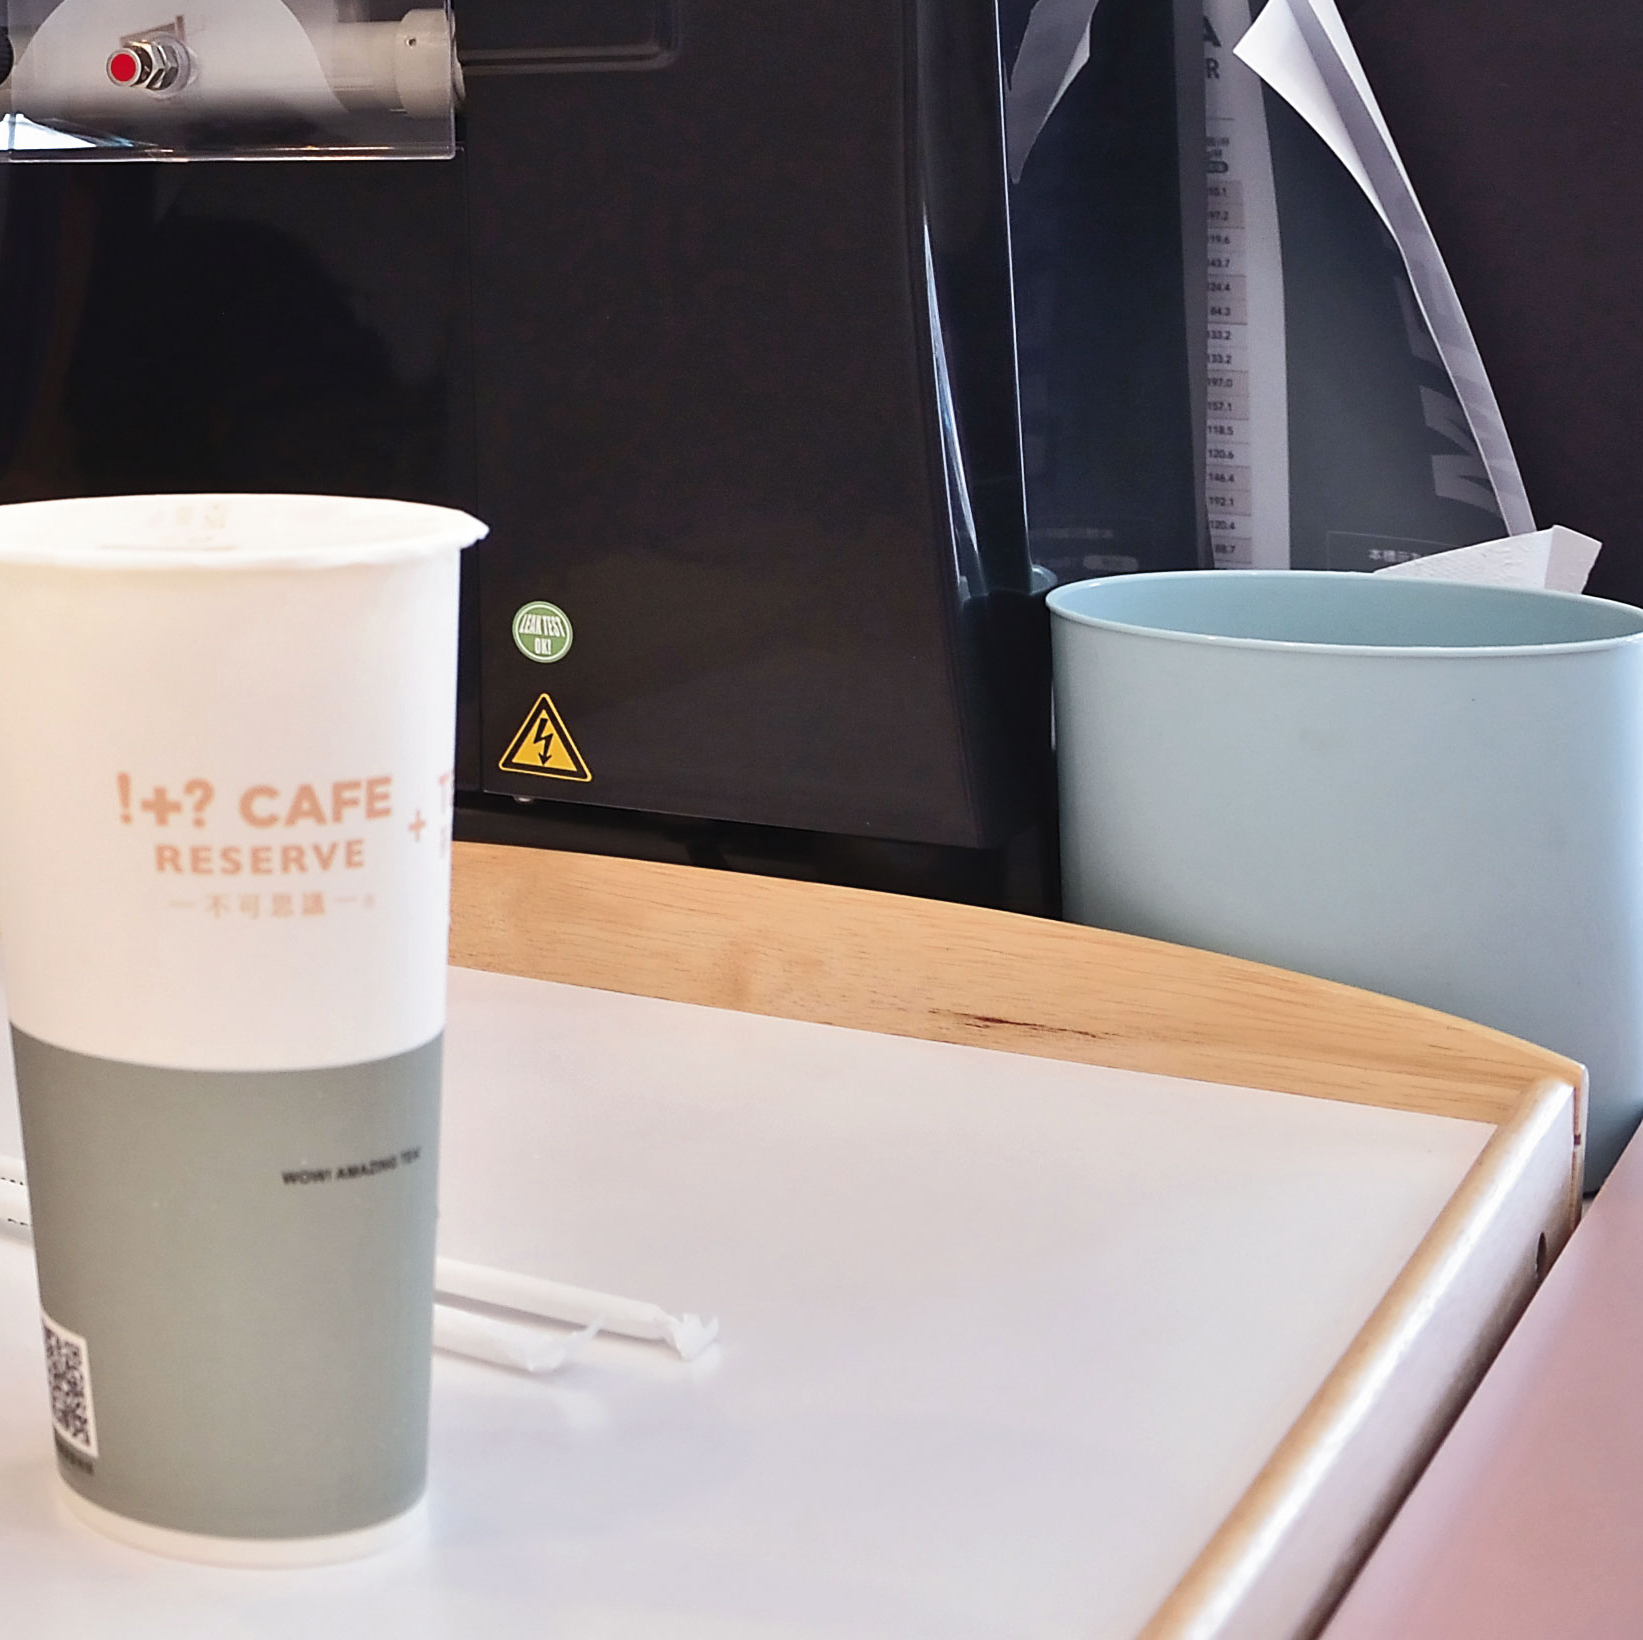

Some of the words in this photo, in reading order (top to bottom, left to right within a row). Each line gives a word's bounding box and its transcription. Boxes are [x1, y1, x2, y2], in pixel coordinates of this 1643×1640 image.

[519, 613, 542, 635] LEAK
[542, 614, 566, 638] TEST
[238, 775, 393, 829] CAFE
[155, 839, 364, 875] RESERVE
